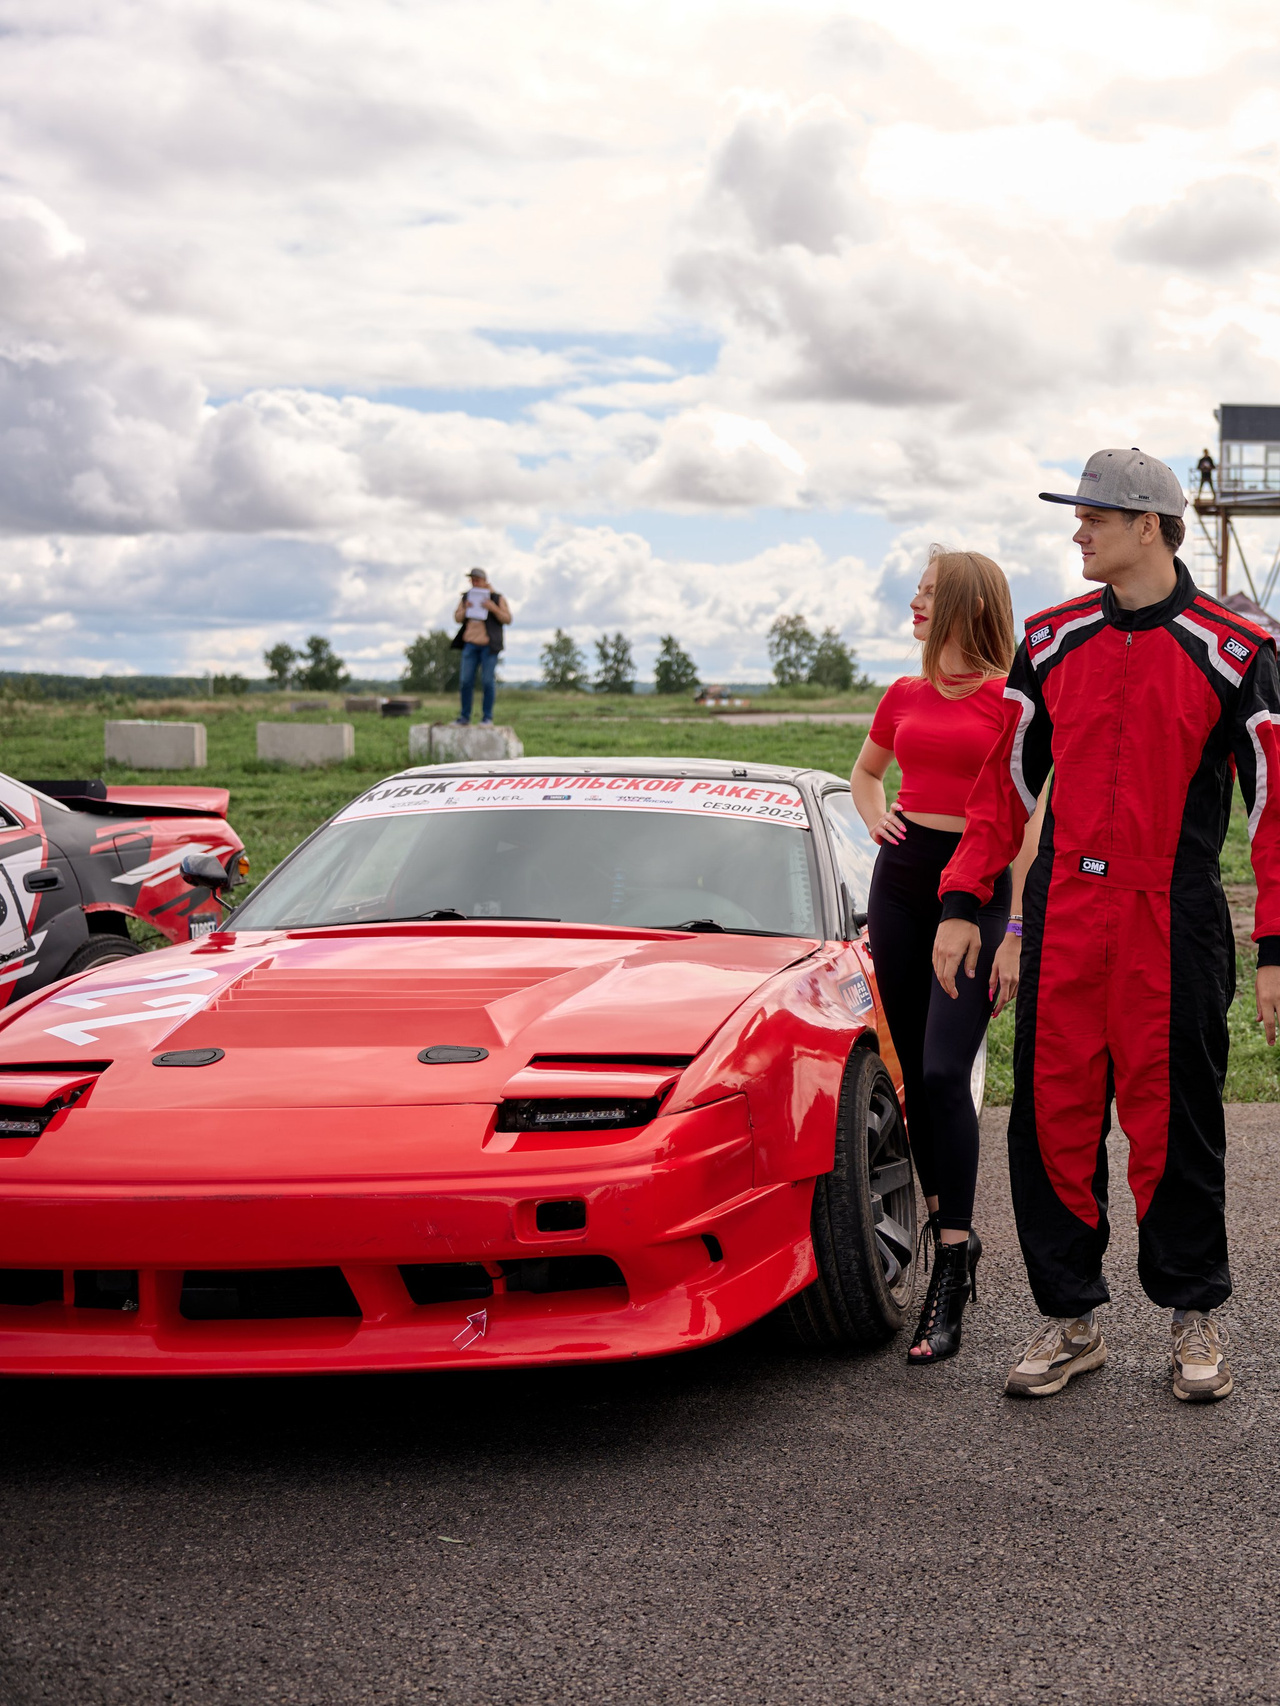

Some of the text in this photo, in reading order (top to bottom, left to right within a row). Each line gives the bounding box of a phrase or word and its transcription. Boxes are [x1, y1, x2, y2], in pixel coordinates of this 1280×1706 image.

[1031, 628, 1050, 643] OMP
[1226, 641, 1248, 658] OMP
[358, 781, 457, 803] КУБОК
[455, 777, 686, 793] БАРНАУЛЬСКОЙ
[689, 782, 804, 808] РАКЕТЫ
[702, 801, 806, 821] СЕЗОН 2025
[1082, 860, 1105, 873] OMP
